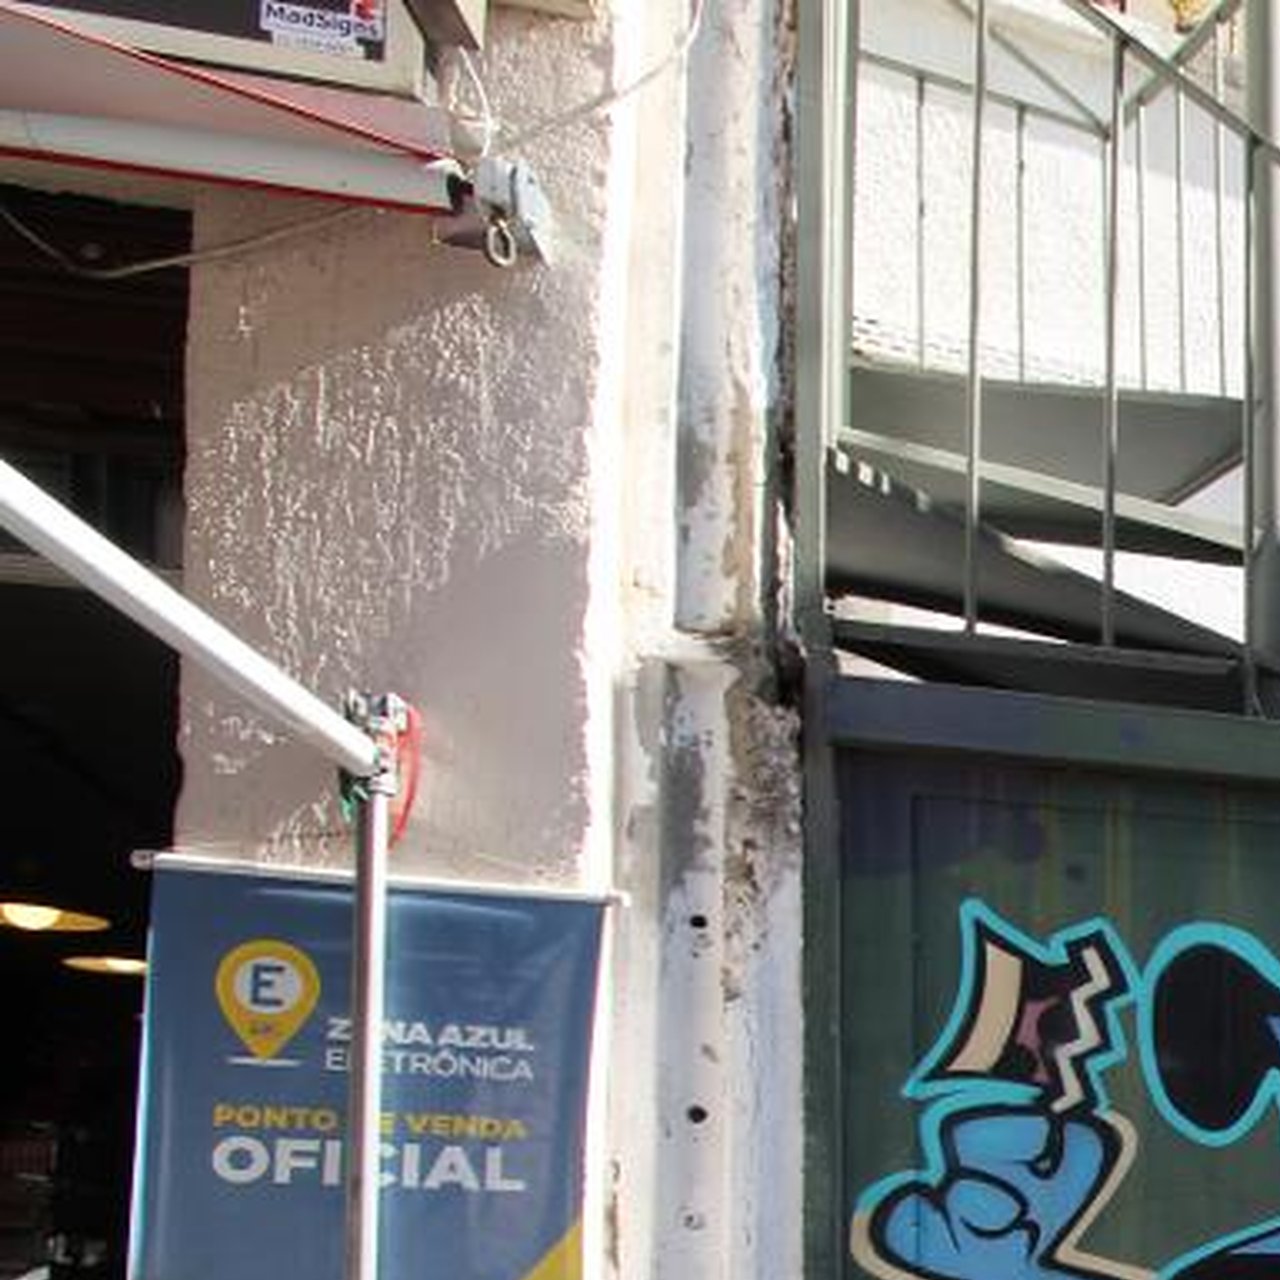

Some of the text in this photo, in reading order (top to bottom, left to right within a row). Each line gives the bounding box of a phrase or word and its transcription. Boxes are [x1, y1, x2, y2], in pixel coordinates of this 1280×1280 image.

[265, 3, 378, 37] MadSigns
[251, 963, 285, 1007] E
[326, 1016, 535, 1051] ZNA AZUL
[213, 1104, 338, 1132] PONTO
[407, 1114, 527, 1141] VENDA
